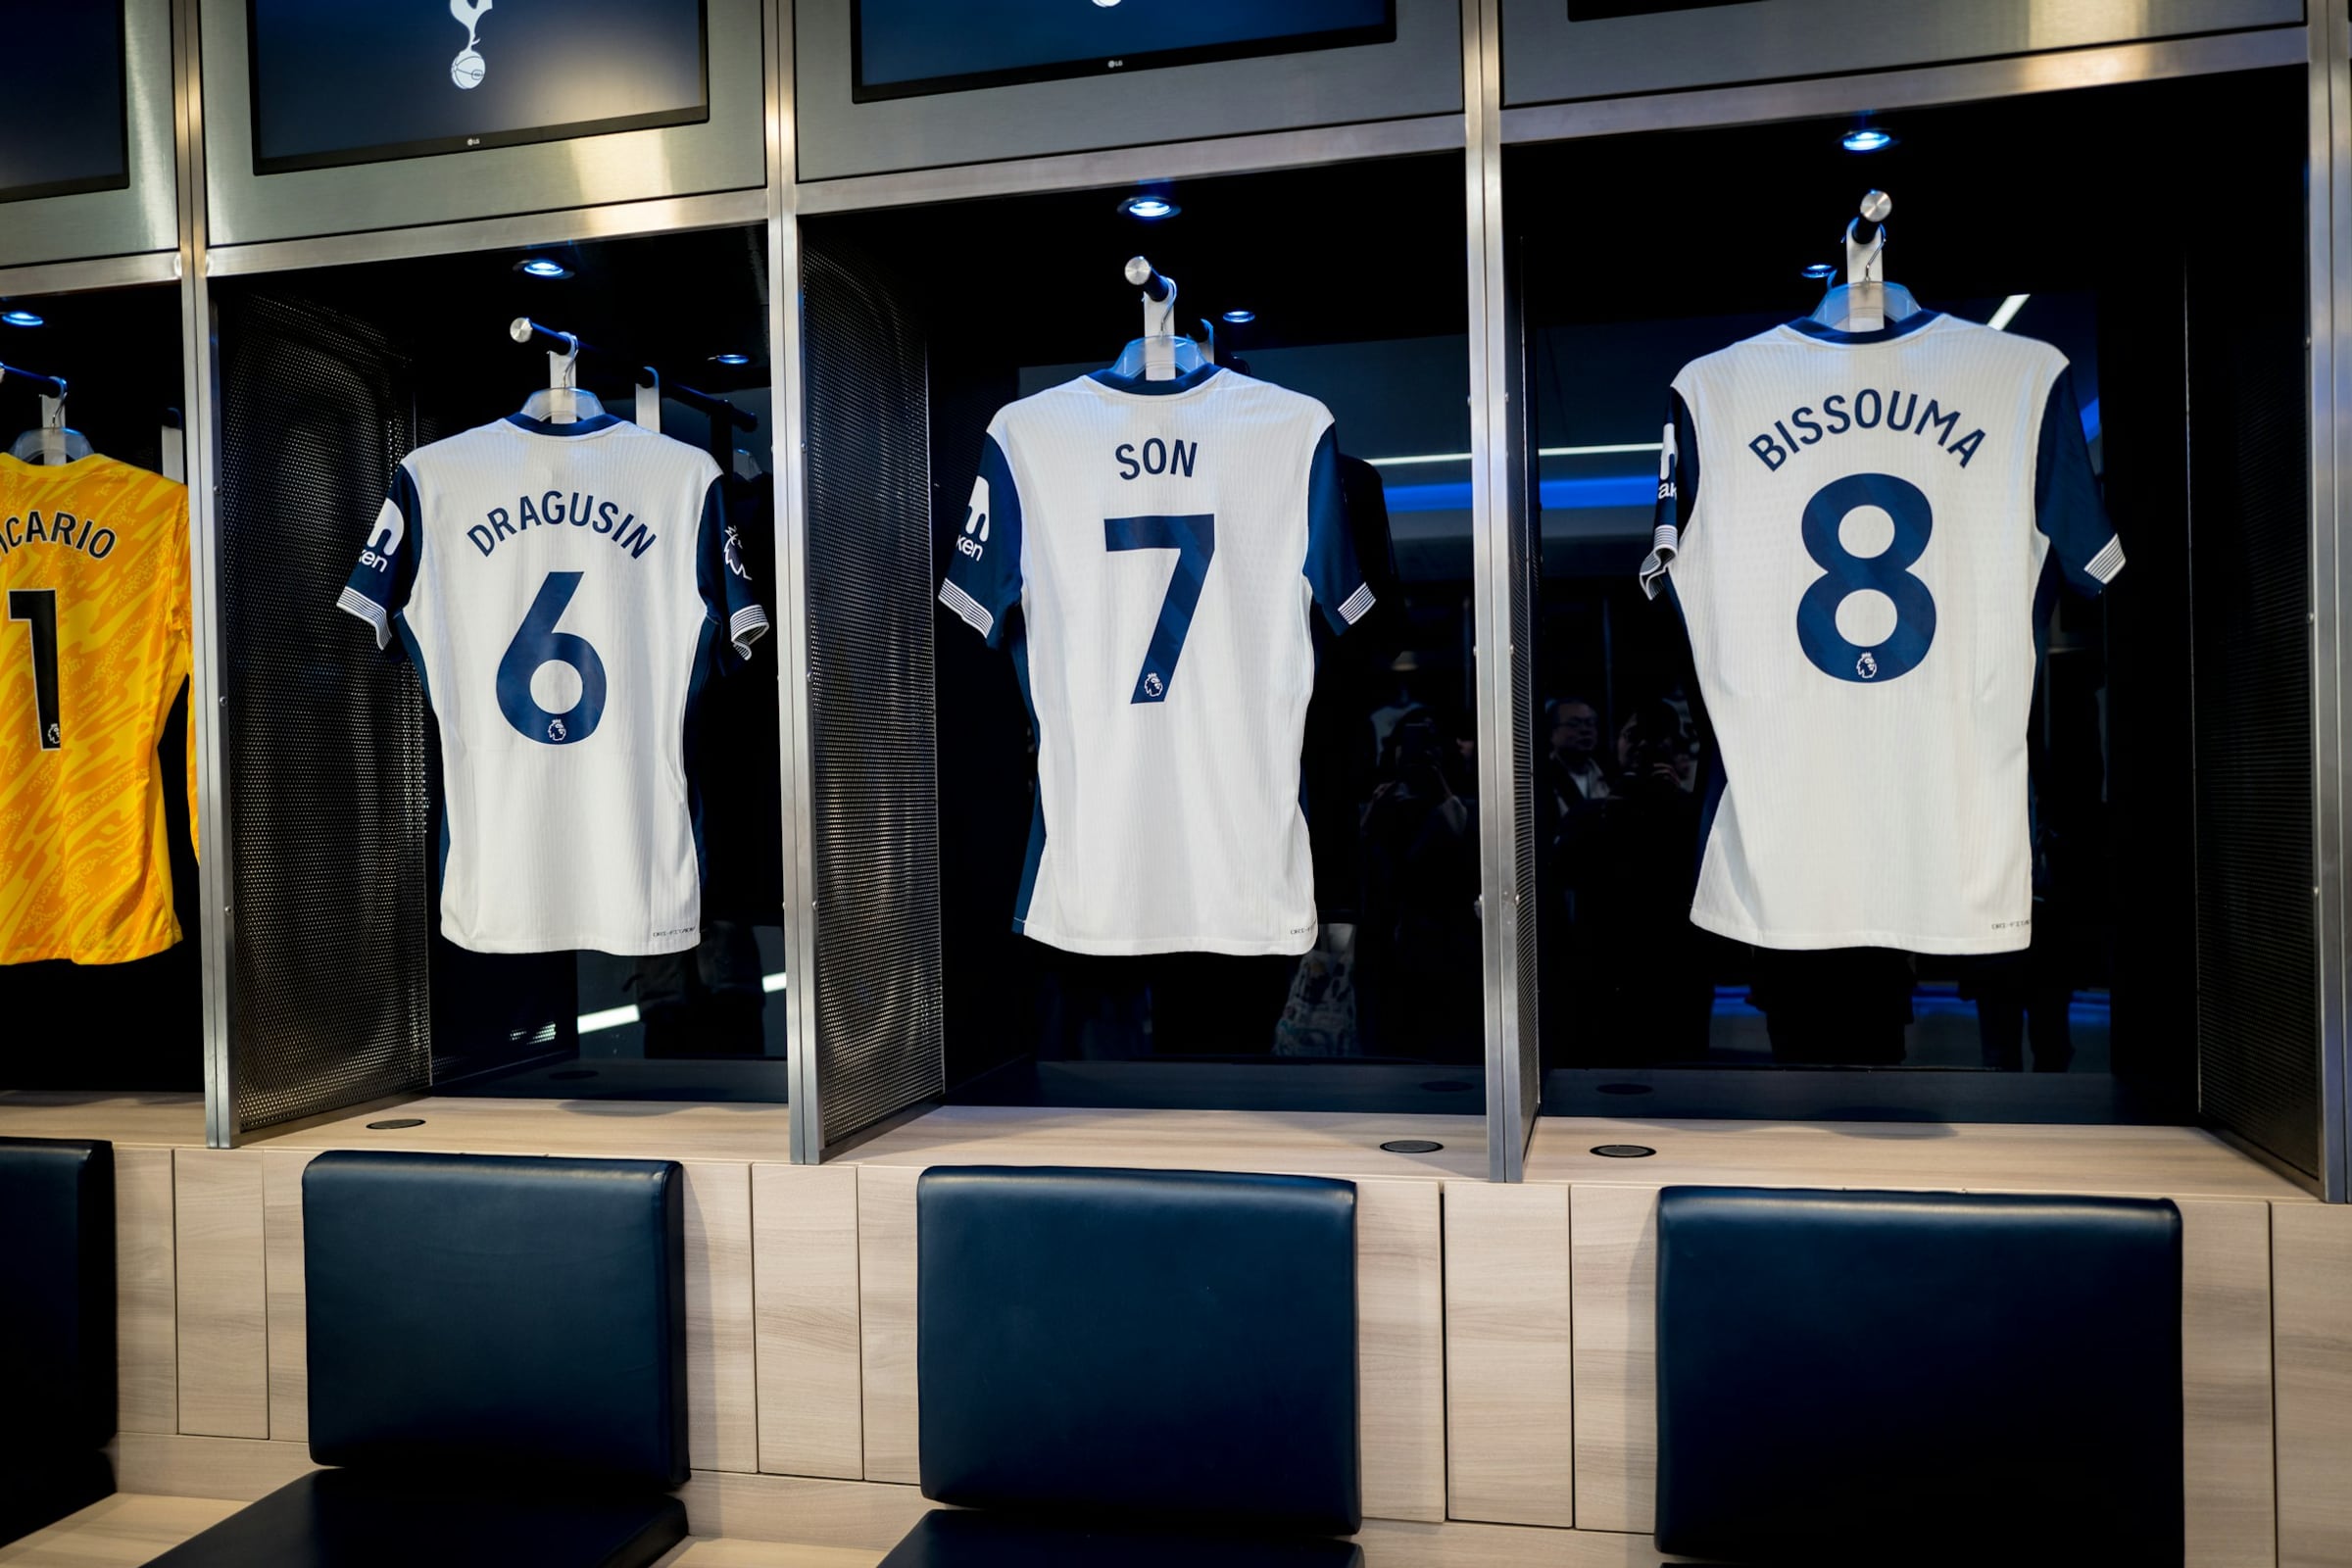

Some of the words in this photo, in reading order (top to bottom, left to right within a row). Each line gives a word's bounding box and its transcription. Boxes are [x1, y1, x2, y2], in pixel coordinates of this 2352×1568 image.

[1115, 438, 1198, 480] SON
[1748, 388, 1986, 472] BISSOUMA
[0, 510, 117, 560] ICARIO
[466, 490, 658, 560] DRAGUSIN
[1796, 472, 1936, 683] 8
[8, 588, 61, 751] 1
[496, 571, 607, 745] 6
[1103, 514, 1215, 705] 7
